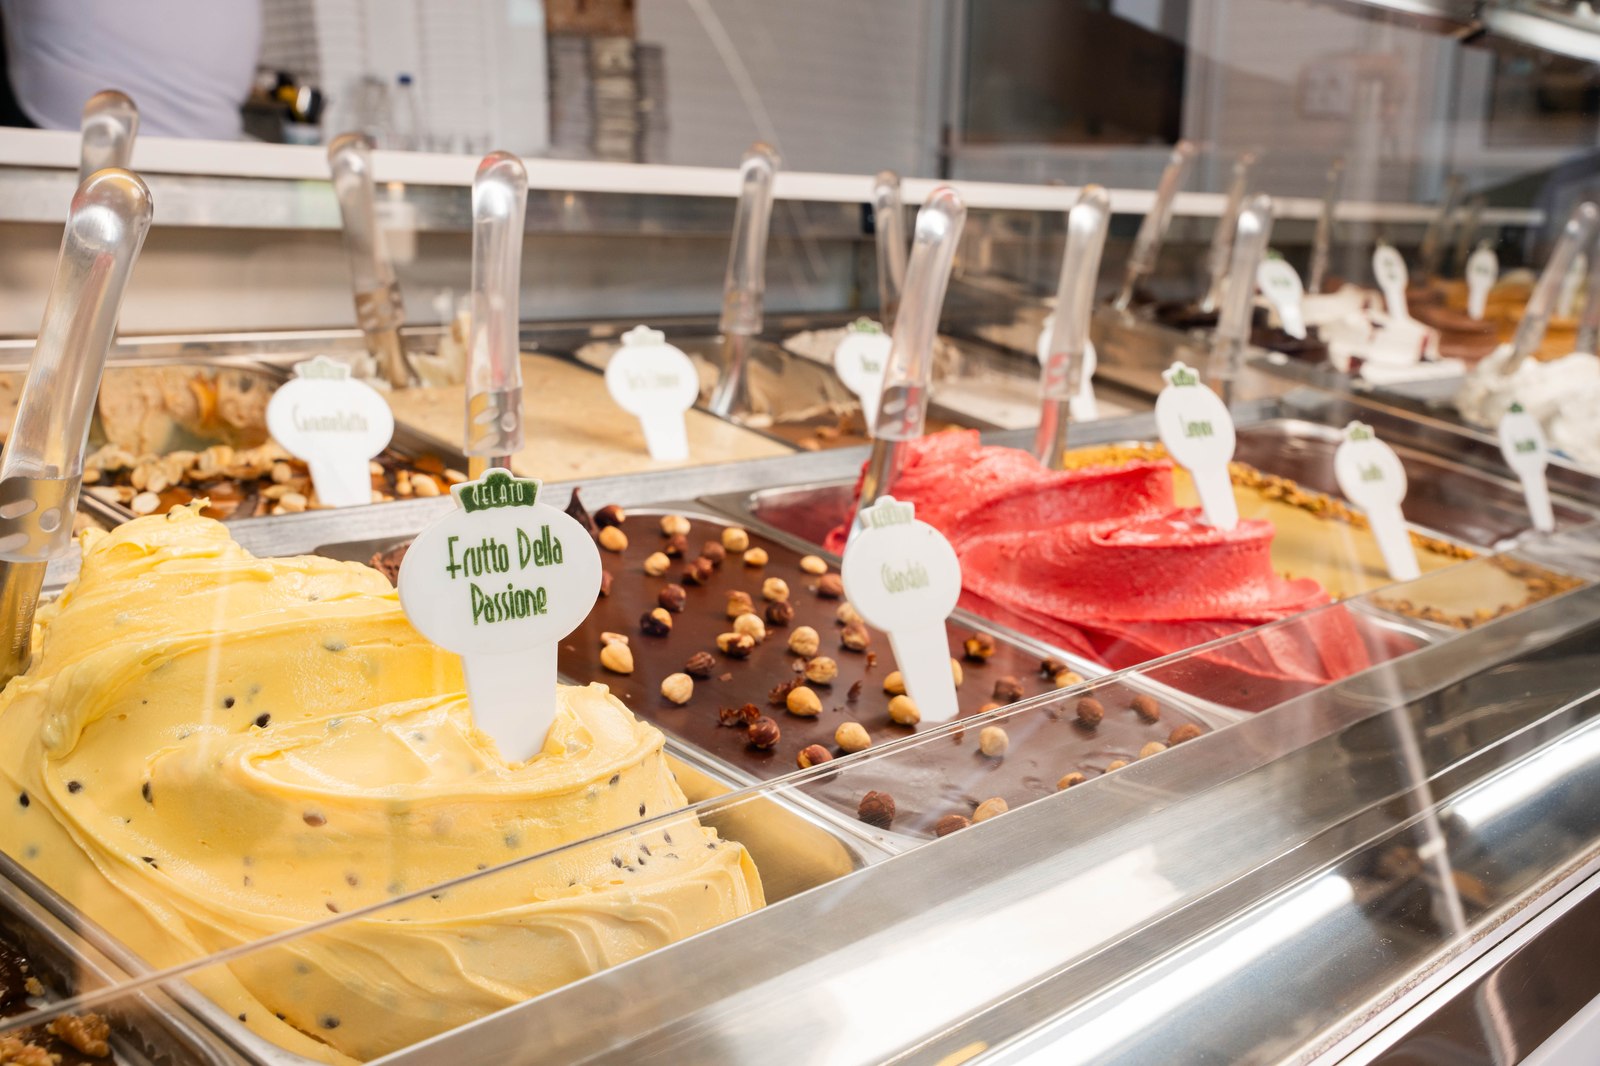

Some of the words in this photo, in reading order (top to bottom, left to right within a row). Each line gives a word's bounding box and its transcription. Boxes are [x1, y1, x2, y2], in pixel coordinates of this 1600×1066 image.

[472, 482, 524, 506] GELATO
[446, 535, 510, 580] Frutto
[516, 524, 564, 570] Della
[470, 582, 548, 626] Passione
